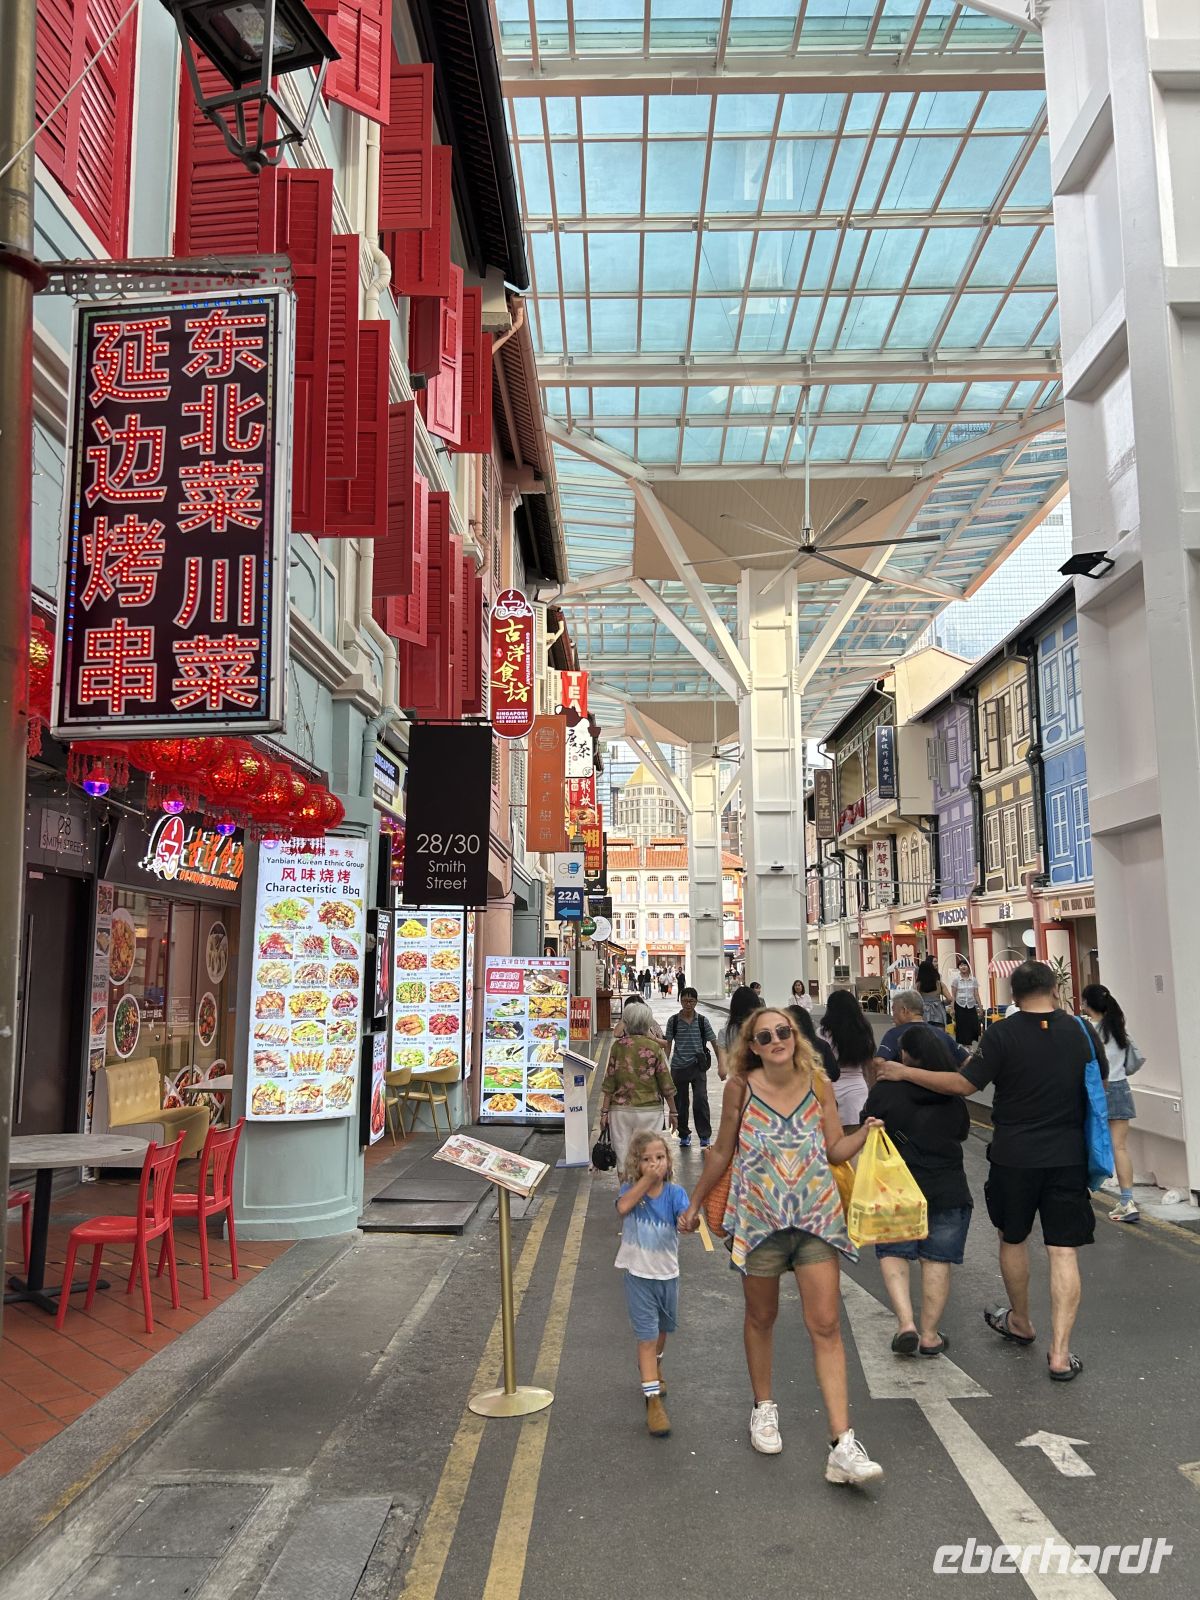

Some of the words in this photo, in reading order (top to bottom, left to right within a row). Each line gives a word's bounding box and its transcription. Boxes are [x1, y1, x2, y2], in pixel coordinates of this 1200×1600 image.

[78, 314, 171, 715] 延边烤串
[172, 308, 267, 711] 东北菜川菜
[58, 815, 72, 836] 28
[42, 835, 62, 850] SMITH
[63, 838, 84, 854] STREET
[416, 833, 480, 856] 28/30
[266, 856, 295, 866] Yanbian
[324, 859, 344, 868] Ethnic
[345, 860, 365, 870] Group
[427, 859, 466, 874] Smith
[280, 867, 352, 884] 风味烧烤
[425, 876, 468, 890] Street
[265, 882, 338, 894] Characteristic
[342, 884, 360, 898] Bbq
[557, 890, 581, 901] 22A
